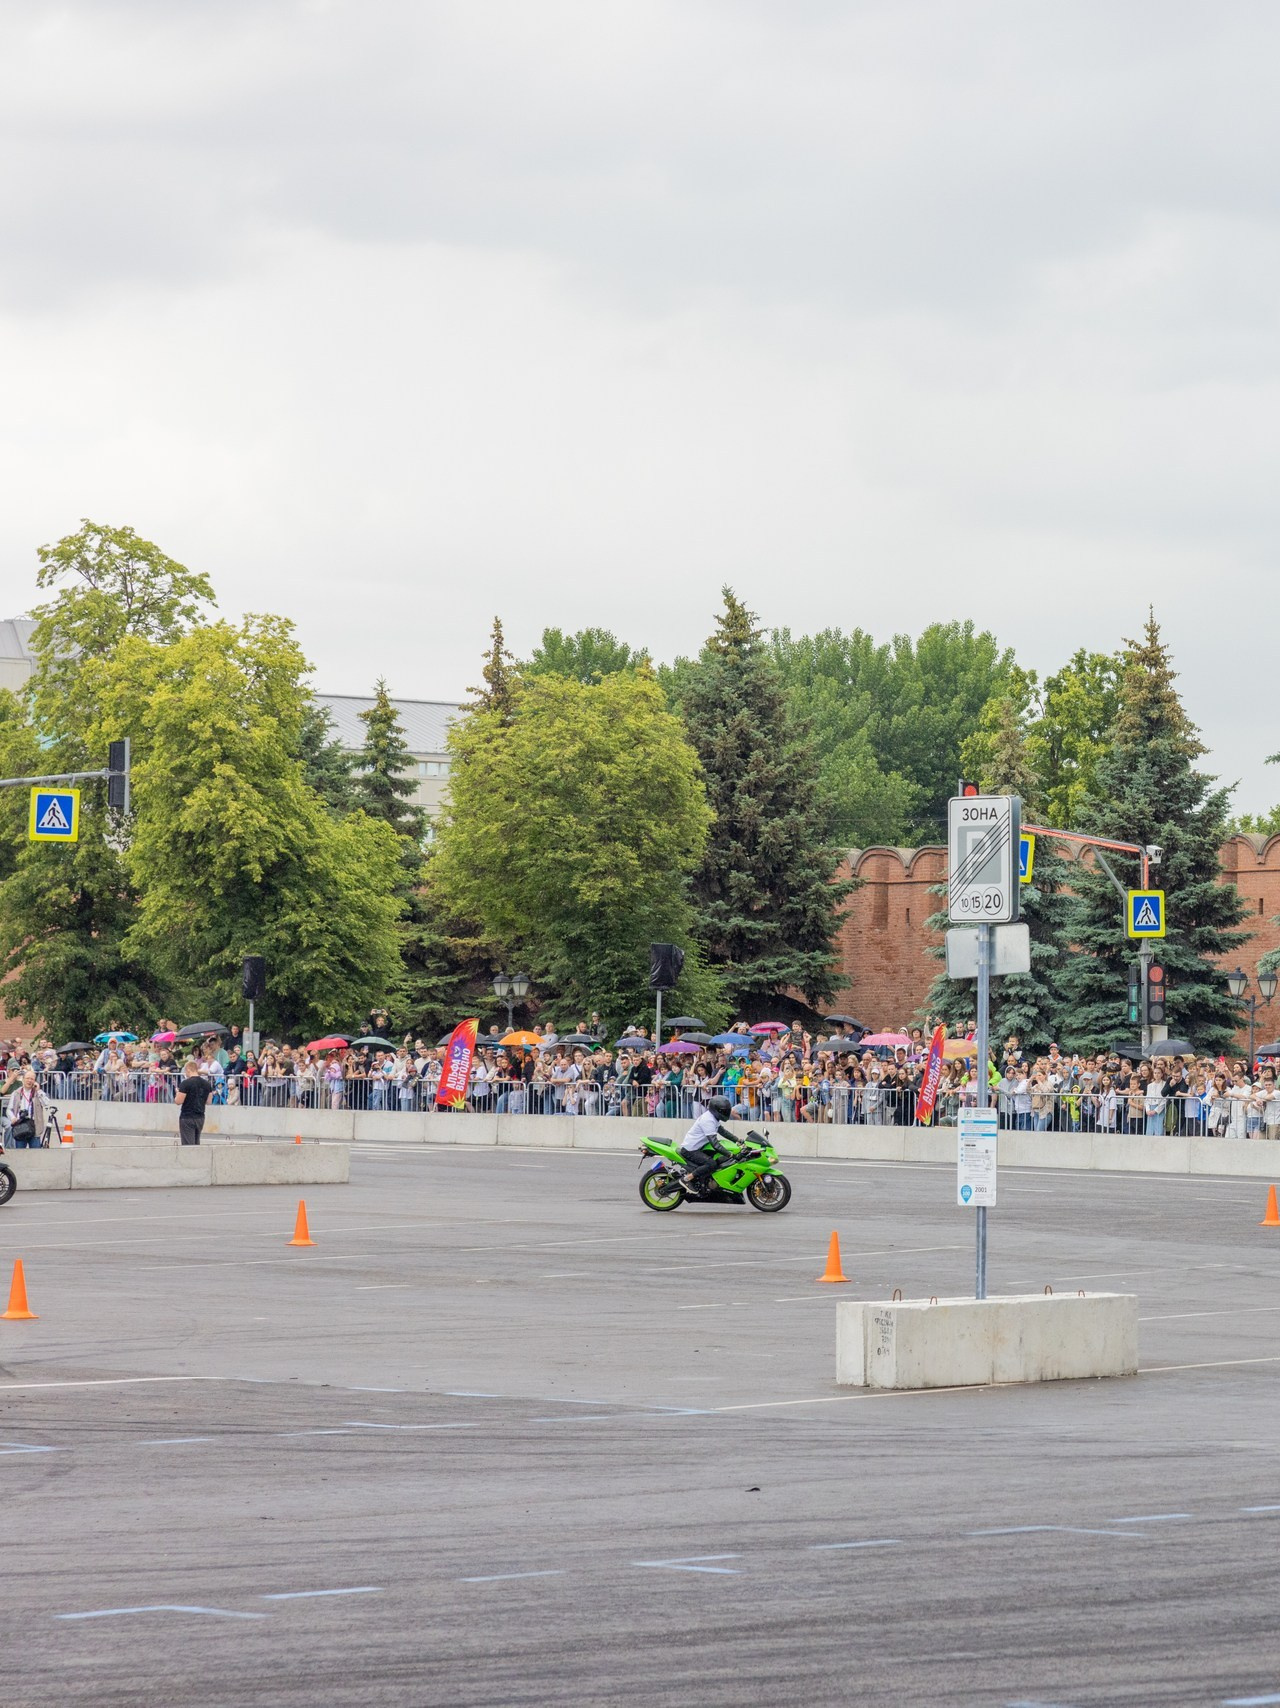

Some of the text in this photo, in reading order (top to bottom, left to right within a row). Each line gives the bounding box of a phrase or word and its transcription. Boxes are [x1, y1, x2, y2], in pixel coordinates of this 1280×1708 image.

[962, 807, 998, 821] ЗОНА
[961, 894, 1001, 909] 10 15 20
[446, 1059, 461, 1089] АЛЬФА
[455, 1048, 471, 1091] ВЫГОДНО
